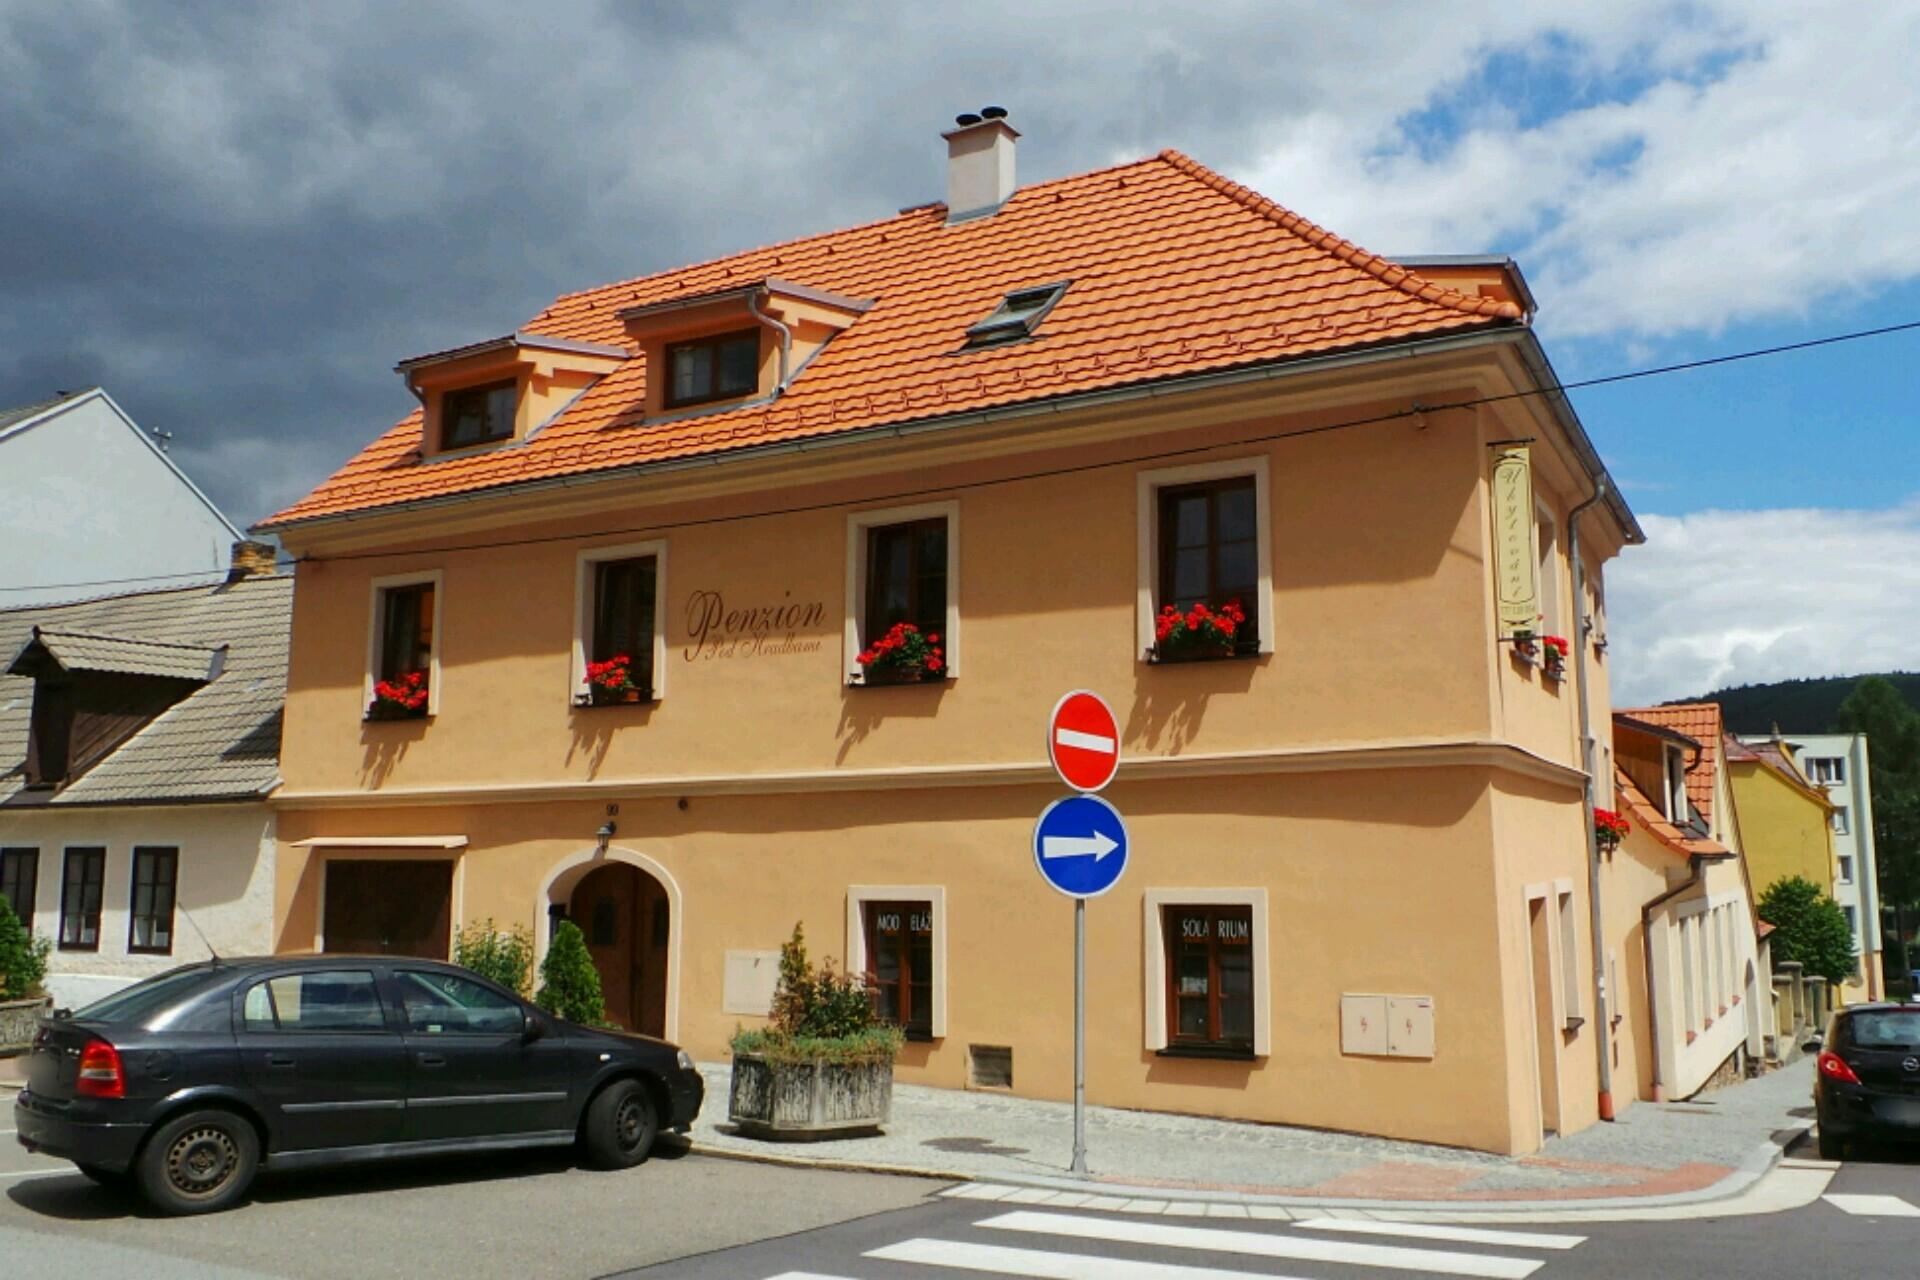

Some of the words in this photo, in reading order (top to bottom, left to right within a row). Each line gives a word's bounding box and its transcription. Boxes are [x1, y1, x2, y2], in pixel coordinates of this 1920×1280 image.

[684, 590, 827, 662] Penzion
[1182, 918, 1210, 937] SOLA
[1217, 919, 1249, 938] RIUM
